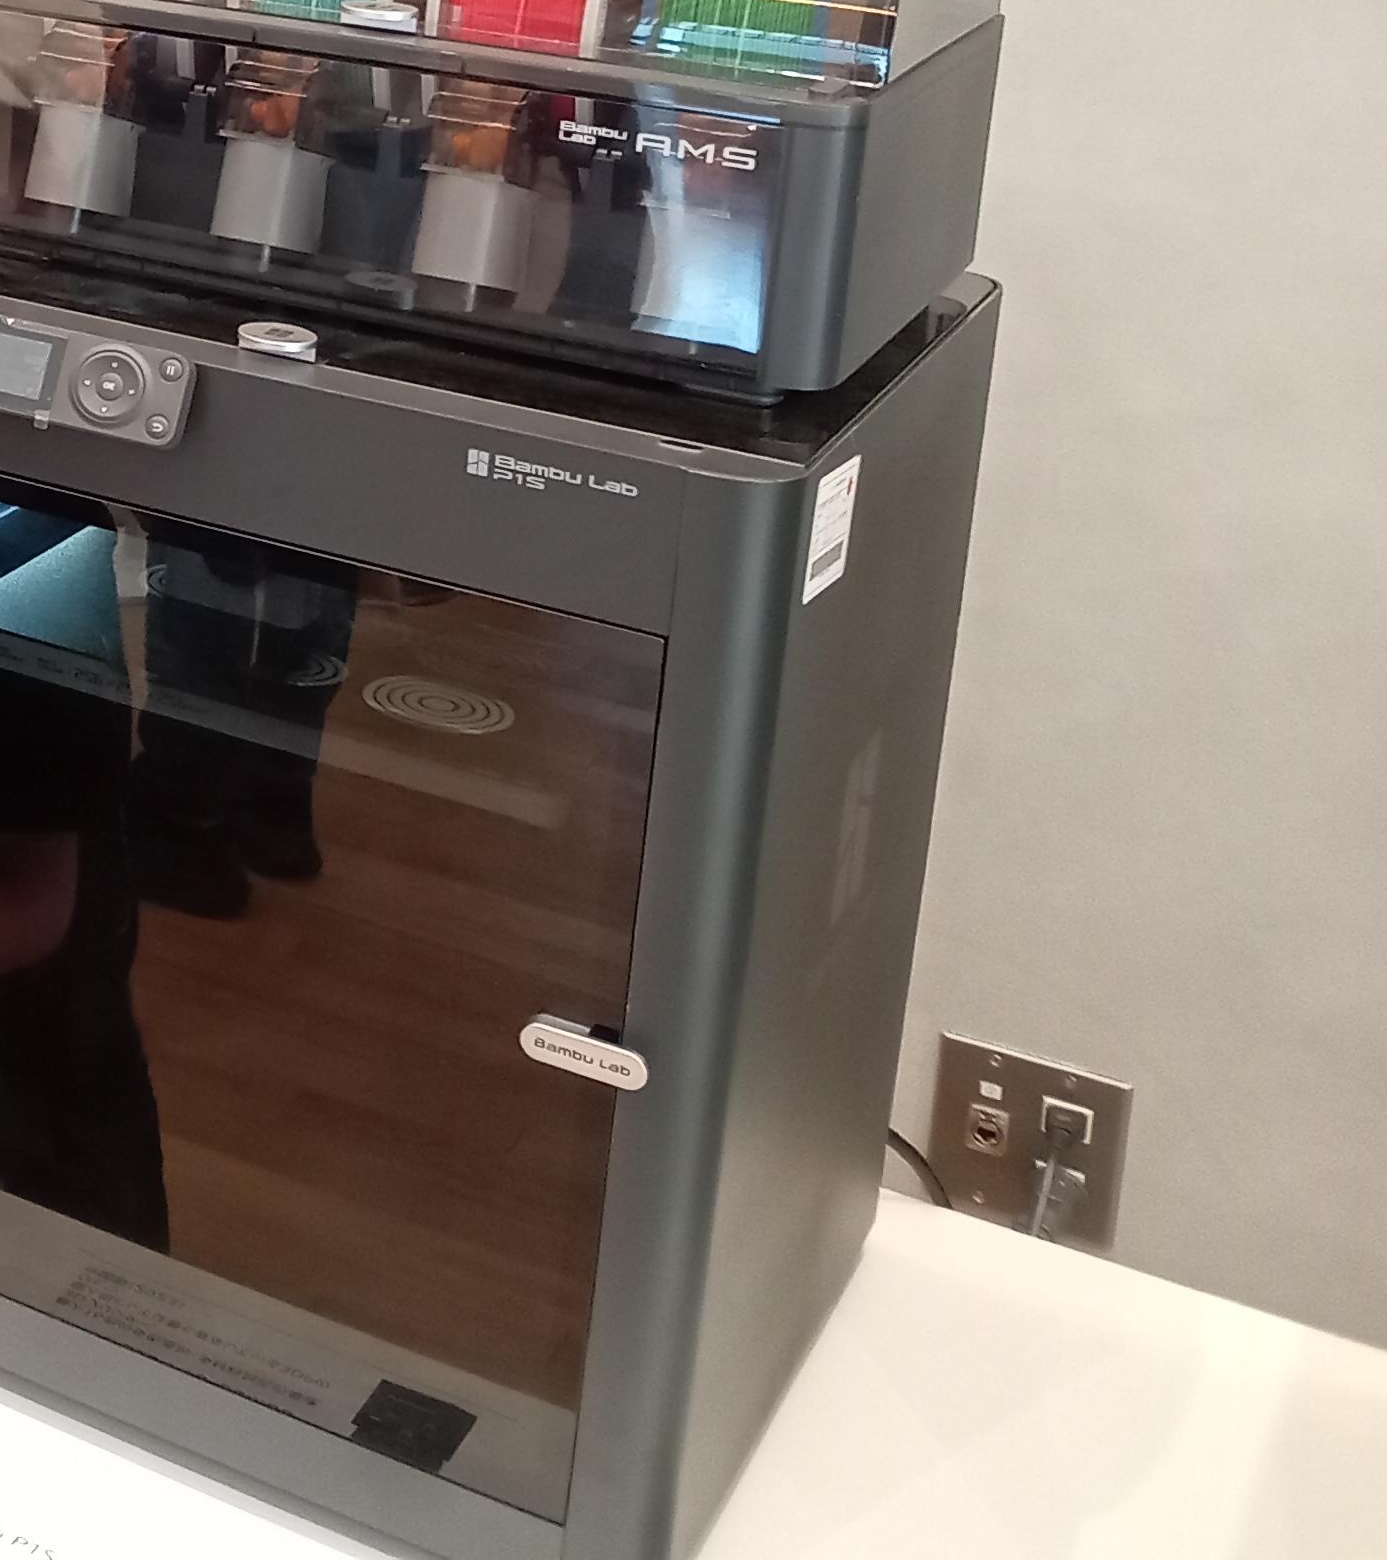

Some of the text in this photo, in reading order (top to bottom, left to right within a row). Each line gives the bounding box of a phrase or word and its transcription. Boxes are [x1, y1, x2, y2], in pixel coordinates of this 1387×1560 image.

[558, 129, 597, 146] Lab
[559, 120, 628, 141] Bambu
[635, 132, 758, 172] AMS
[493, 468, 546, 490] P1S
[494, 454, 640, 498] Bambu Lab
[534, 1037, 631, 1077] Bambu Lab
